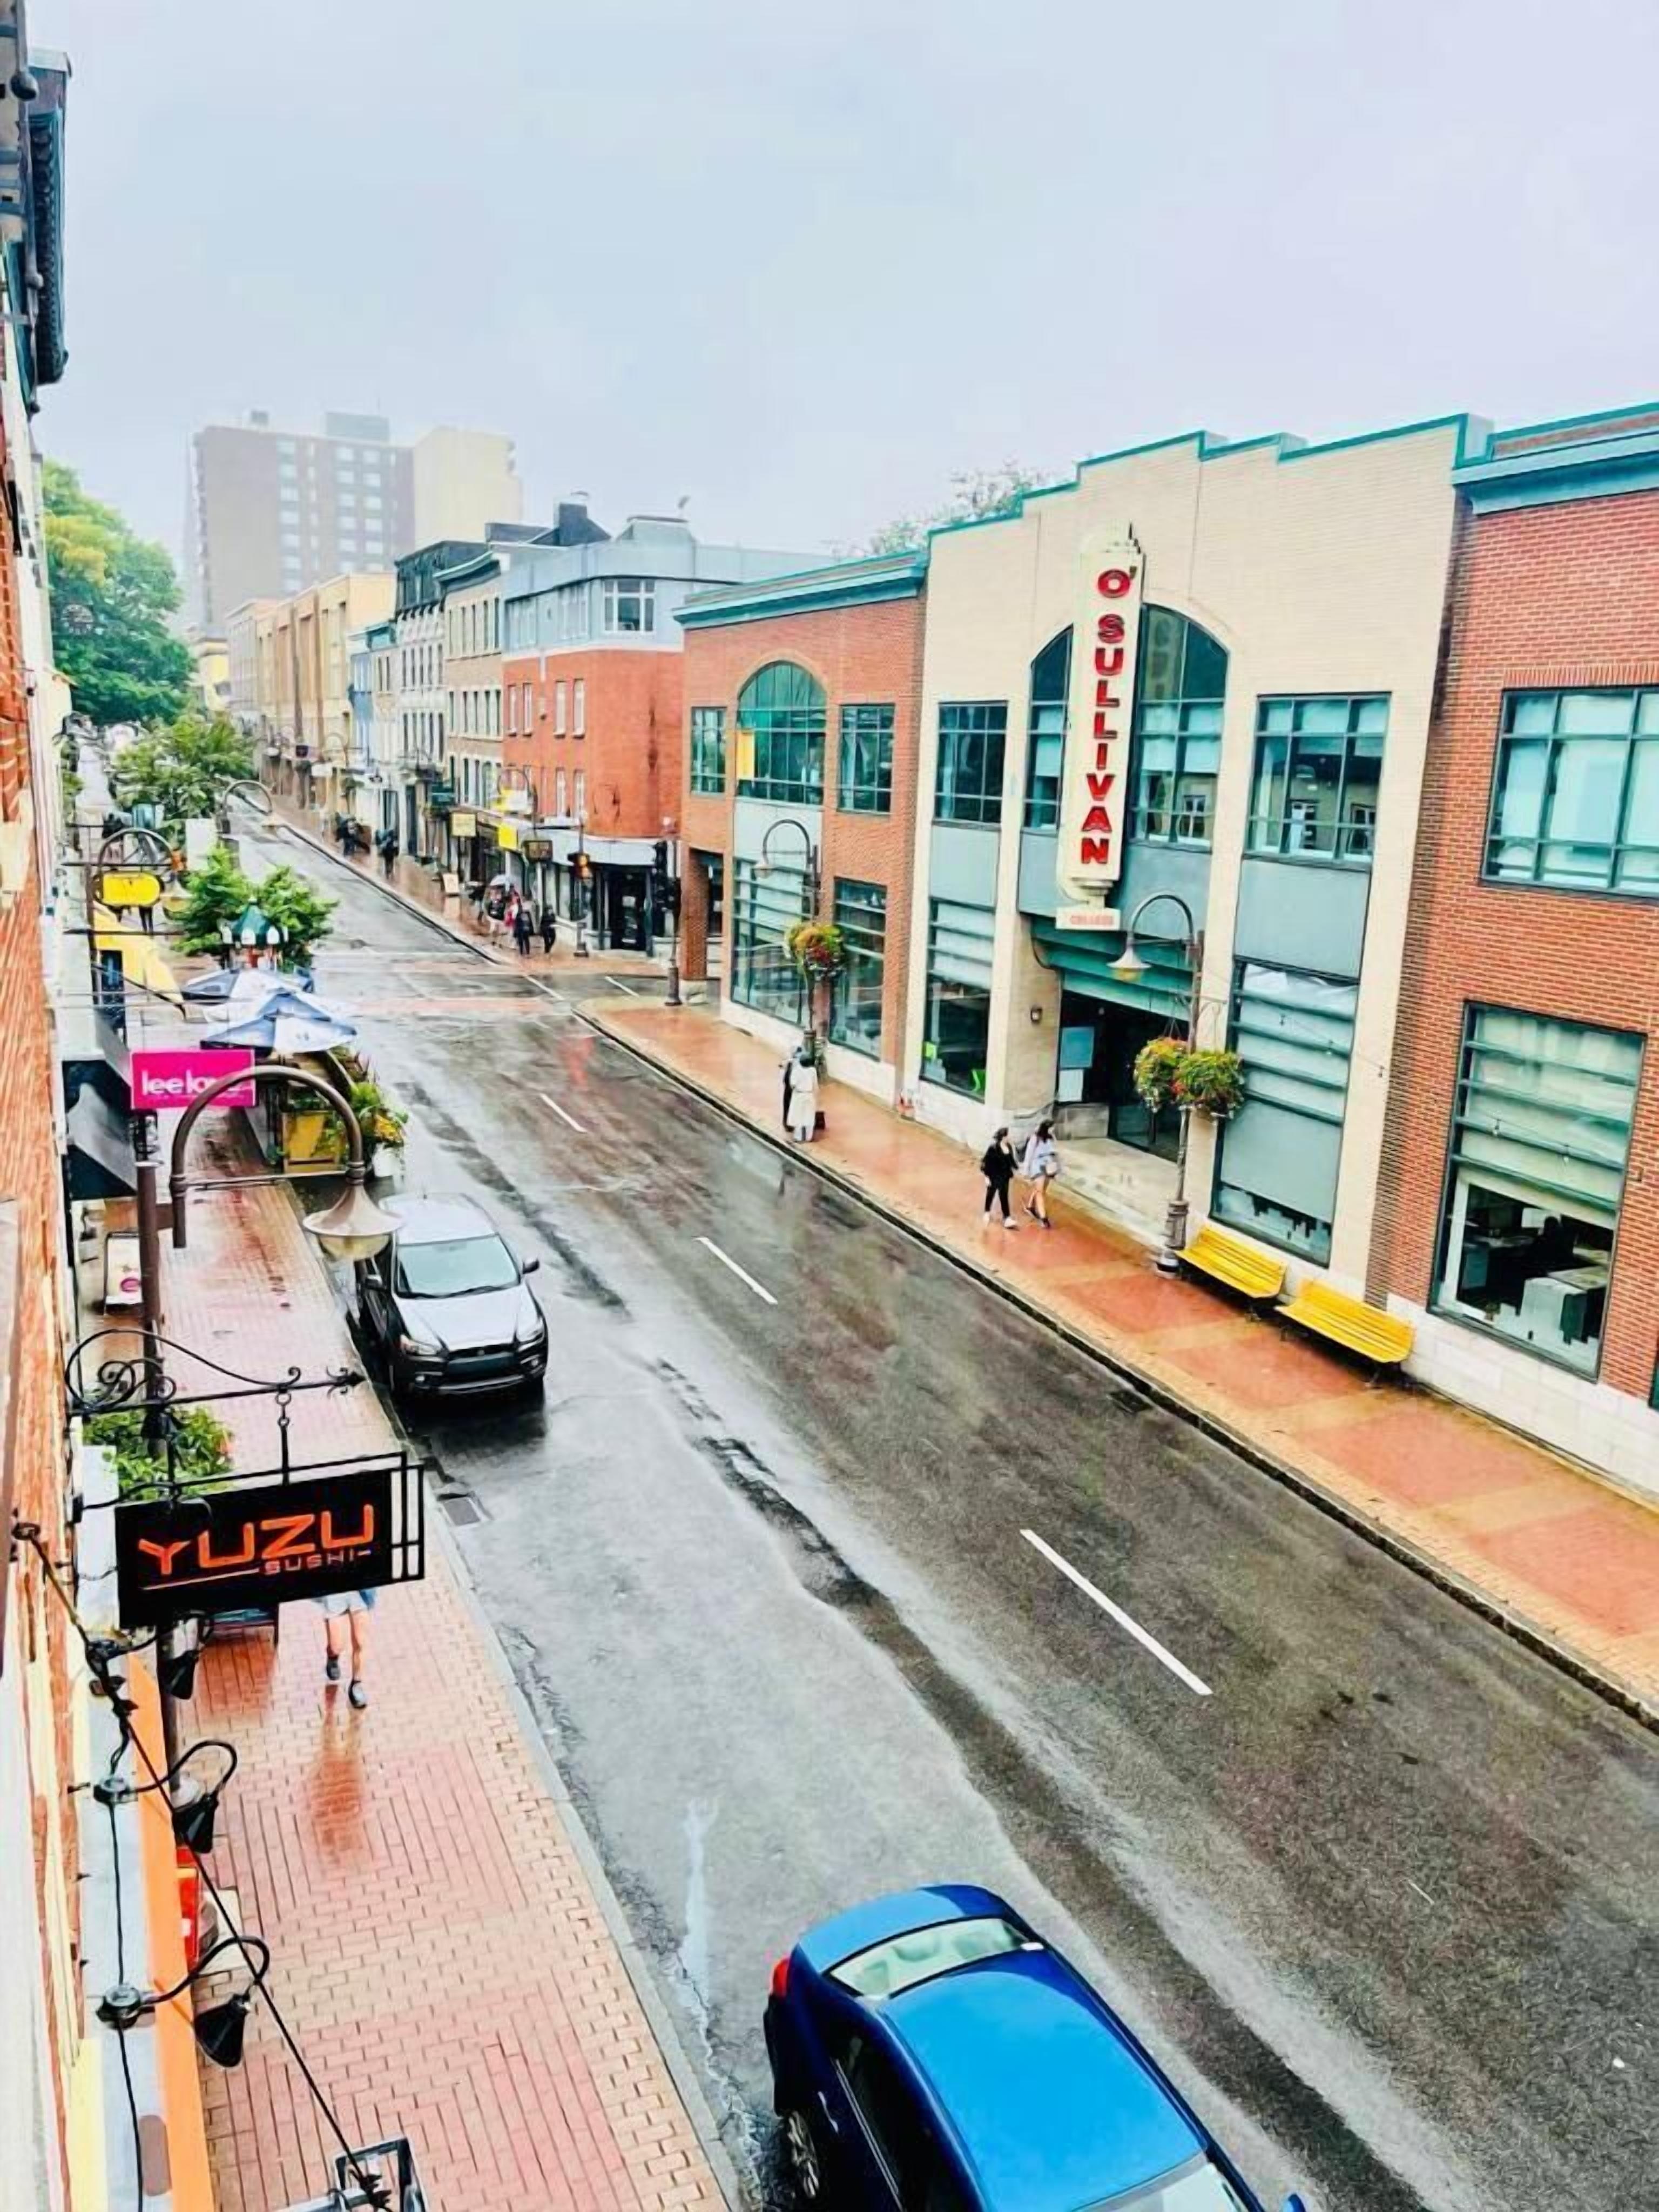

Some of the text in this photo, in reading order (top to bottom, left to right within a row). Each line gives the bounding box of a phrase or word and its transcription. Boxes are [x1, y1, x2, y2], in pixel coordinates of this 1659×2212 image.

[1081, 566, 1137, 864] O'SULLIVAN
[138, 1504, 374, 1575] YUZU
[264, 1548, 354, 1575] SUSHI
